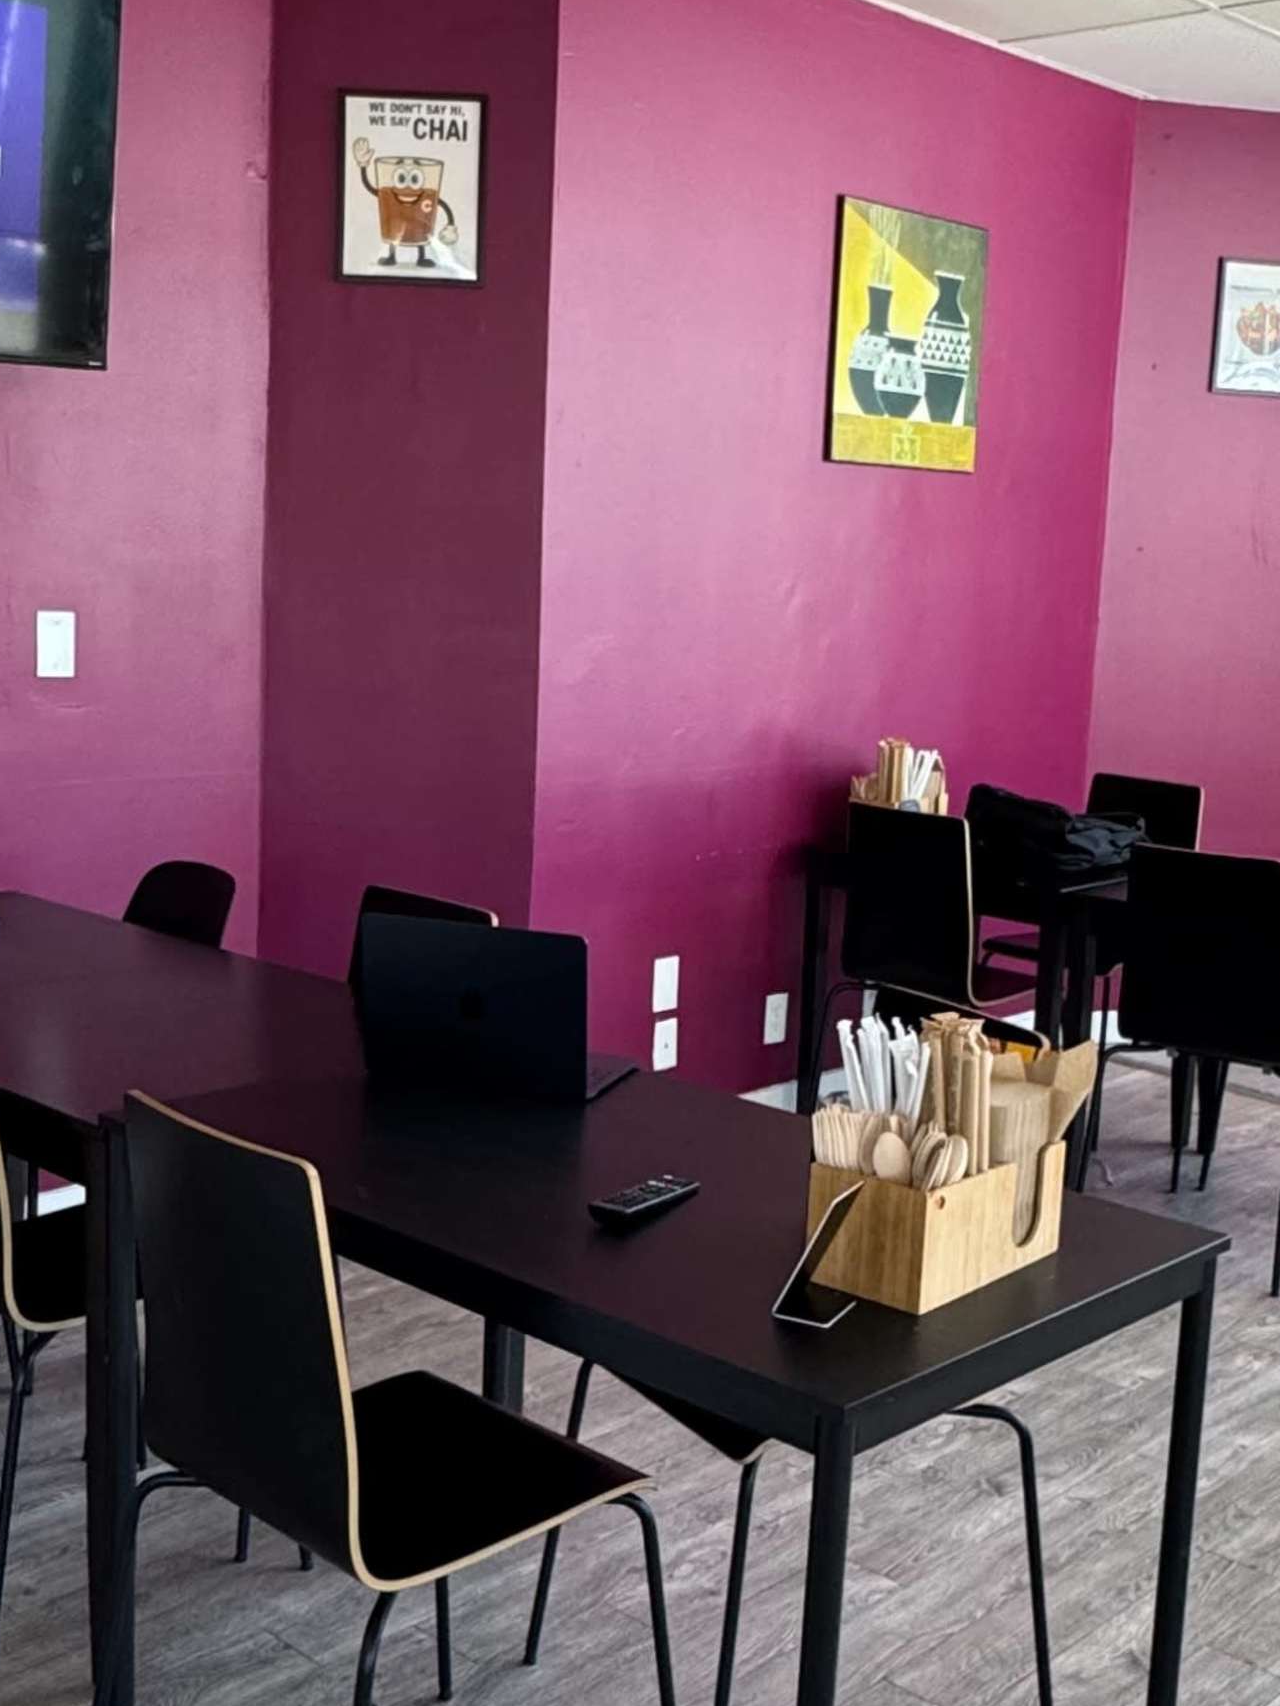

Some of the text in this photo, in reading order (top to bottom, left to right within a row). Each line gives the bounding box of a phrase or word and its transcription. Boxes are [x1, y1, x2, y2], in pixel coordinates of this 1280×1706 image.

[369, 102, 386, 113] WE
[390, 102, 422, 114] DON'T
[426, 104, 446, 115] SAY
[369, 115, 468, 141] WE SAY CHAI
